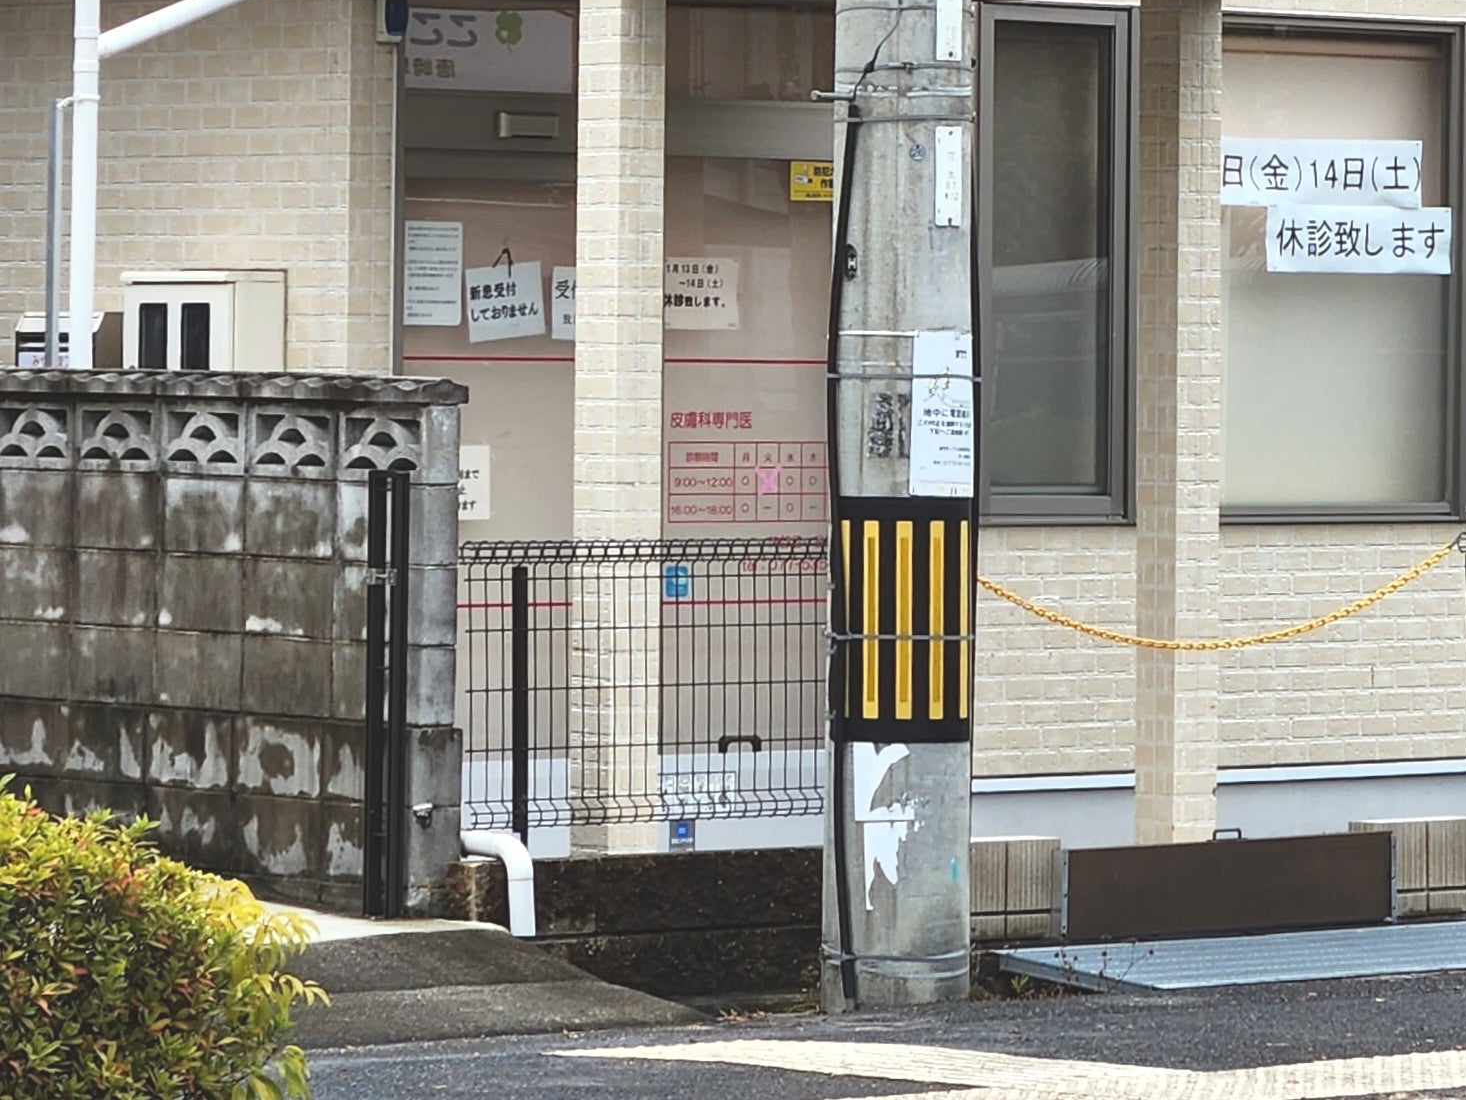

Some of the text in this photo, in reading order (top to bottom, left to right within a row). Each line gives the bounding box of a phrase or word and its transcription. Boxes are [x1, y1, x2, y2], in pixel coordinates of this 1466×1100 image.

[1276, 218, 1446, 259] 休診致します
[471, 302, 539, 322] しておりません
[669, 411, 753, 429] 皮膚科専門医
